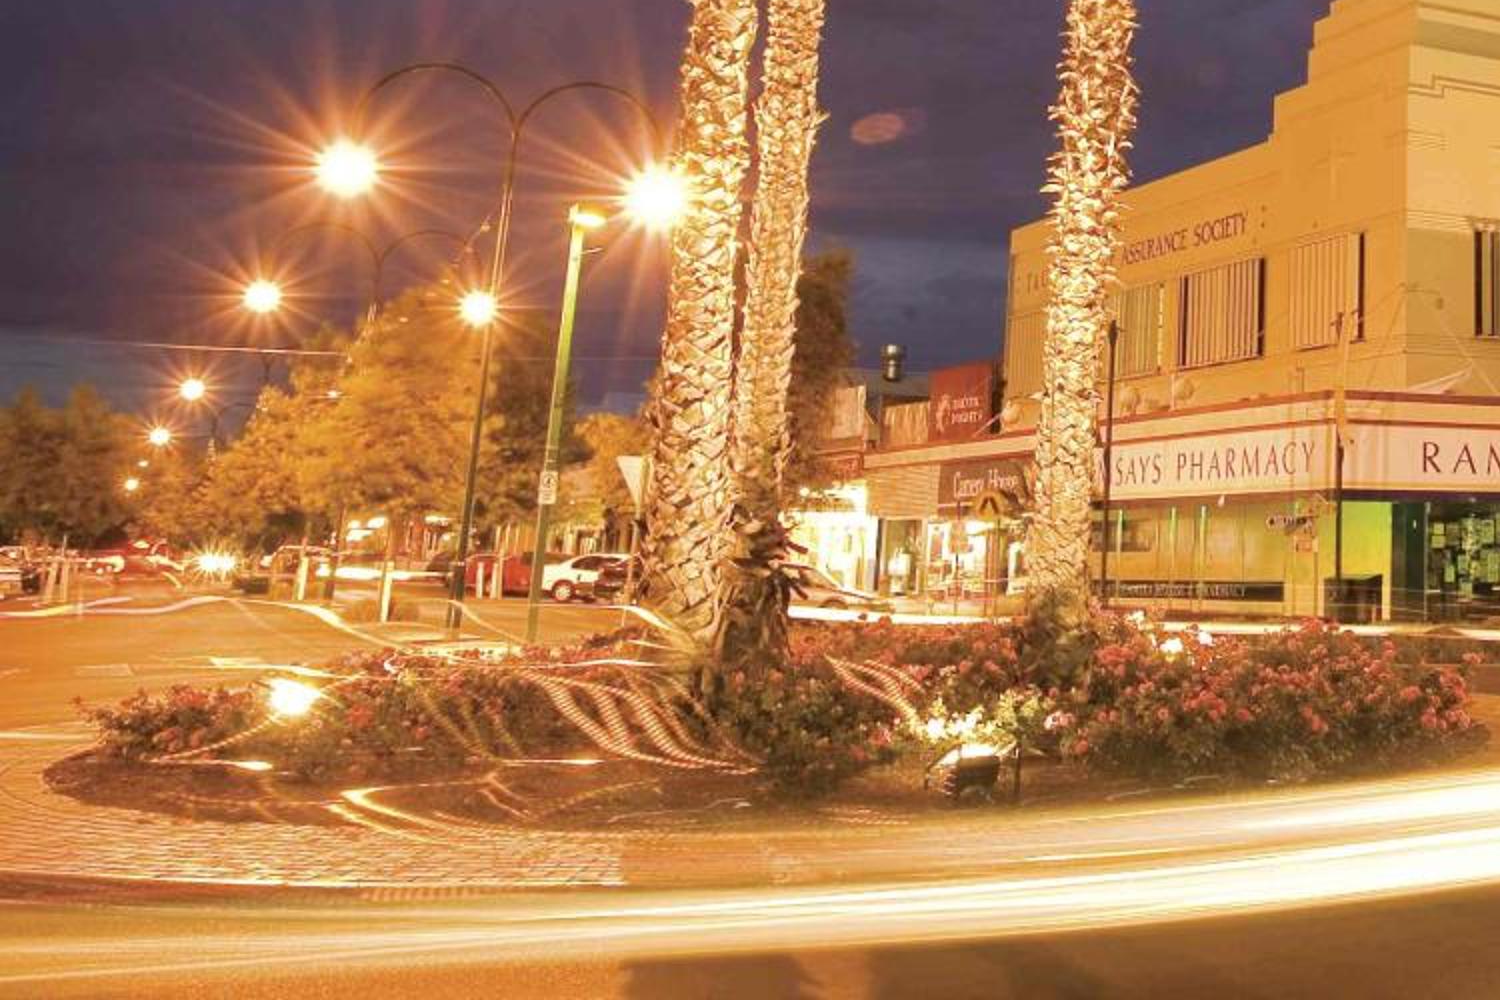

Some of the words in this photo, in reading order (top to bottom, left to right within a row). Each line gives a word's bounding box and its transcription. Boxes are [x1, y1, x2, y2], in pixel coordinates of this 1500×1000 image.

[1121, 228, 1189, 265] ASSURANCE
[1193, 211, 1250, 248] SOCIETY
[1176, 440, 1316, 482] PHARMACY
